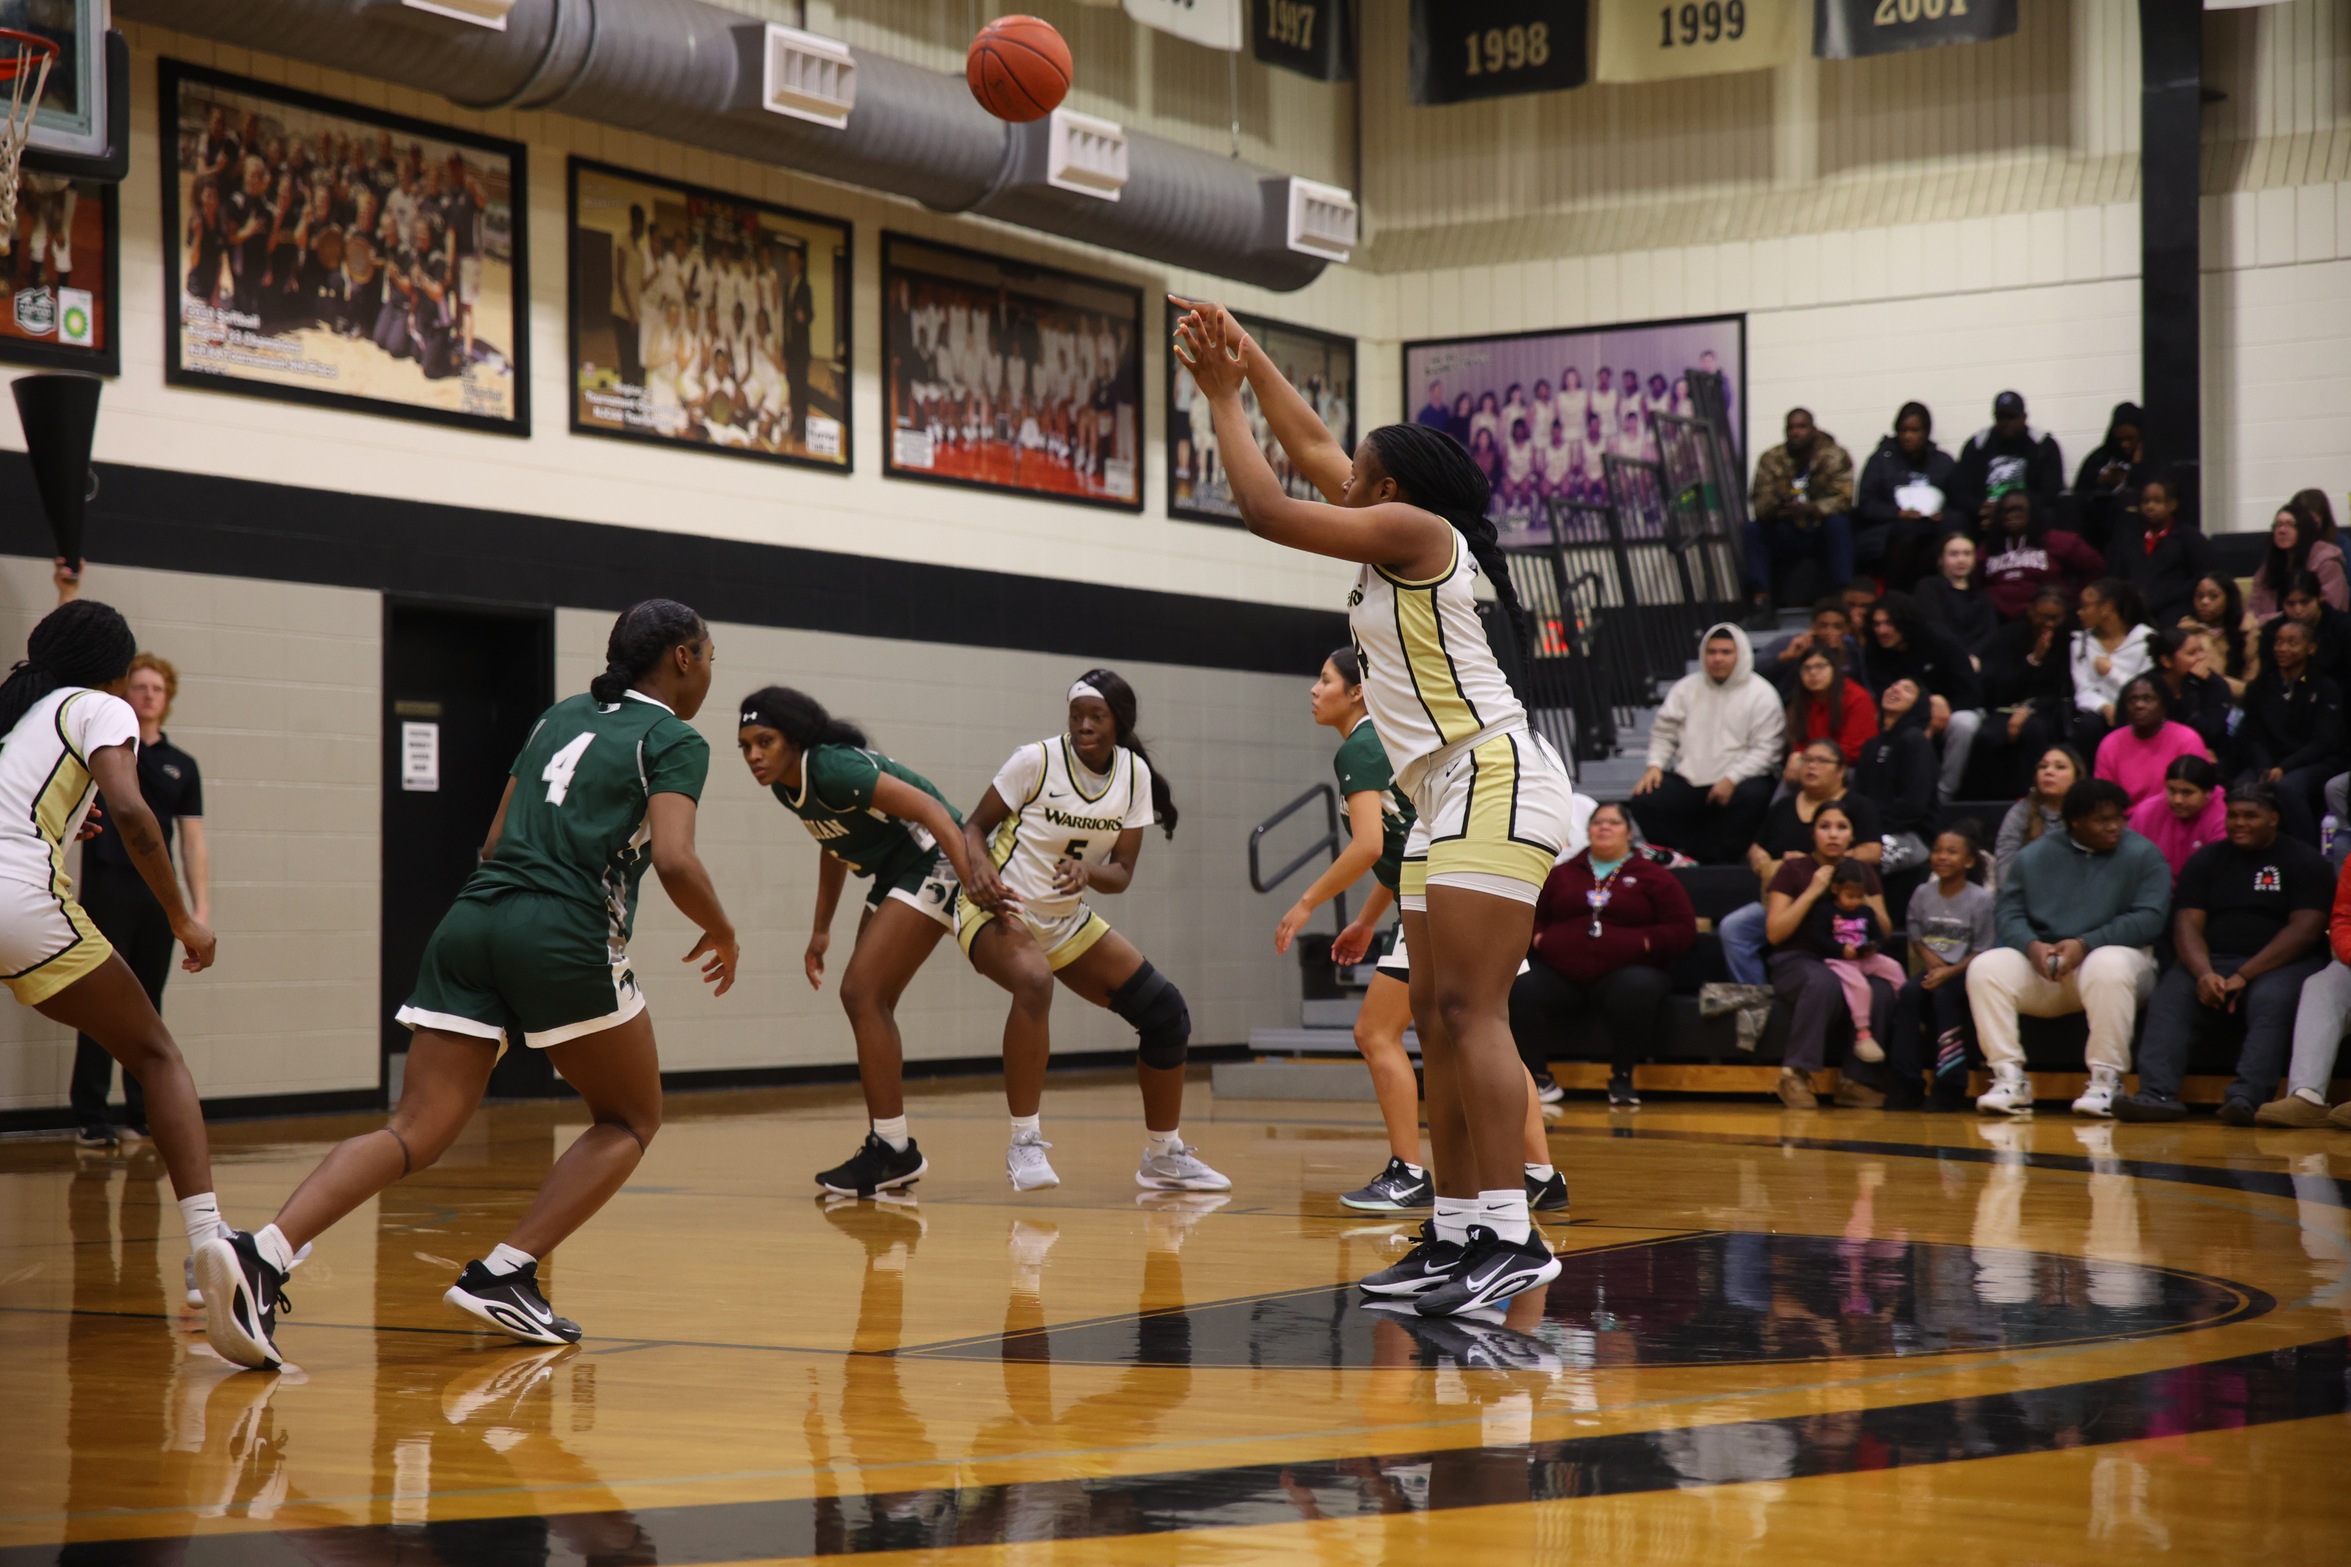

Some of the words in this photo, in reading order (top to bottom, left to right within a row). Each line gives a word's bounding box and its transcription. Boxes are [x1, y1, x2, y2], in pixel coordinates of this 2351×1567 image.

[1659, 0, 1745, 48] 1999
[1465, 21, 1549, 77] 1998
[541, 731, 597, 807] 4
[1045, 807, 1122, 831] WARRIORS
[1058, 838, 1089, 865] 5
